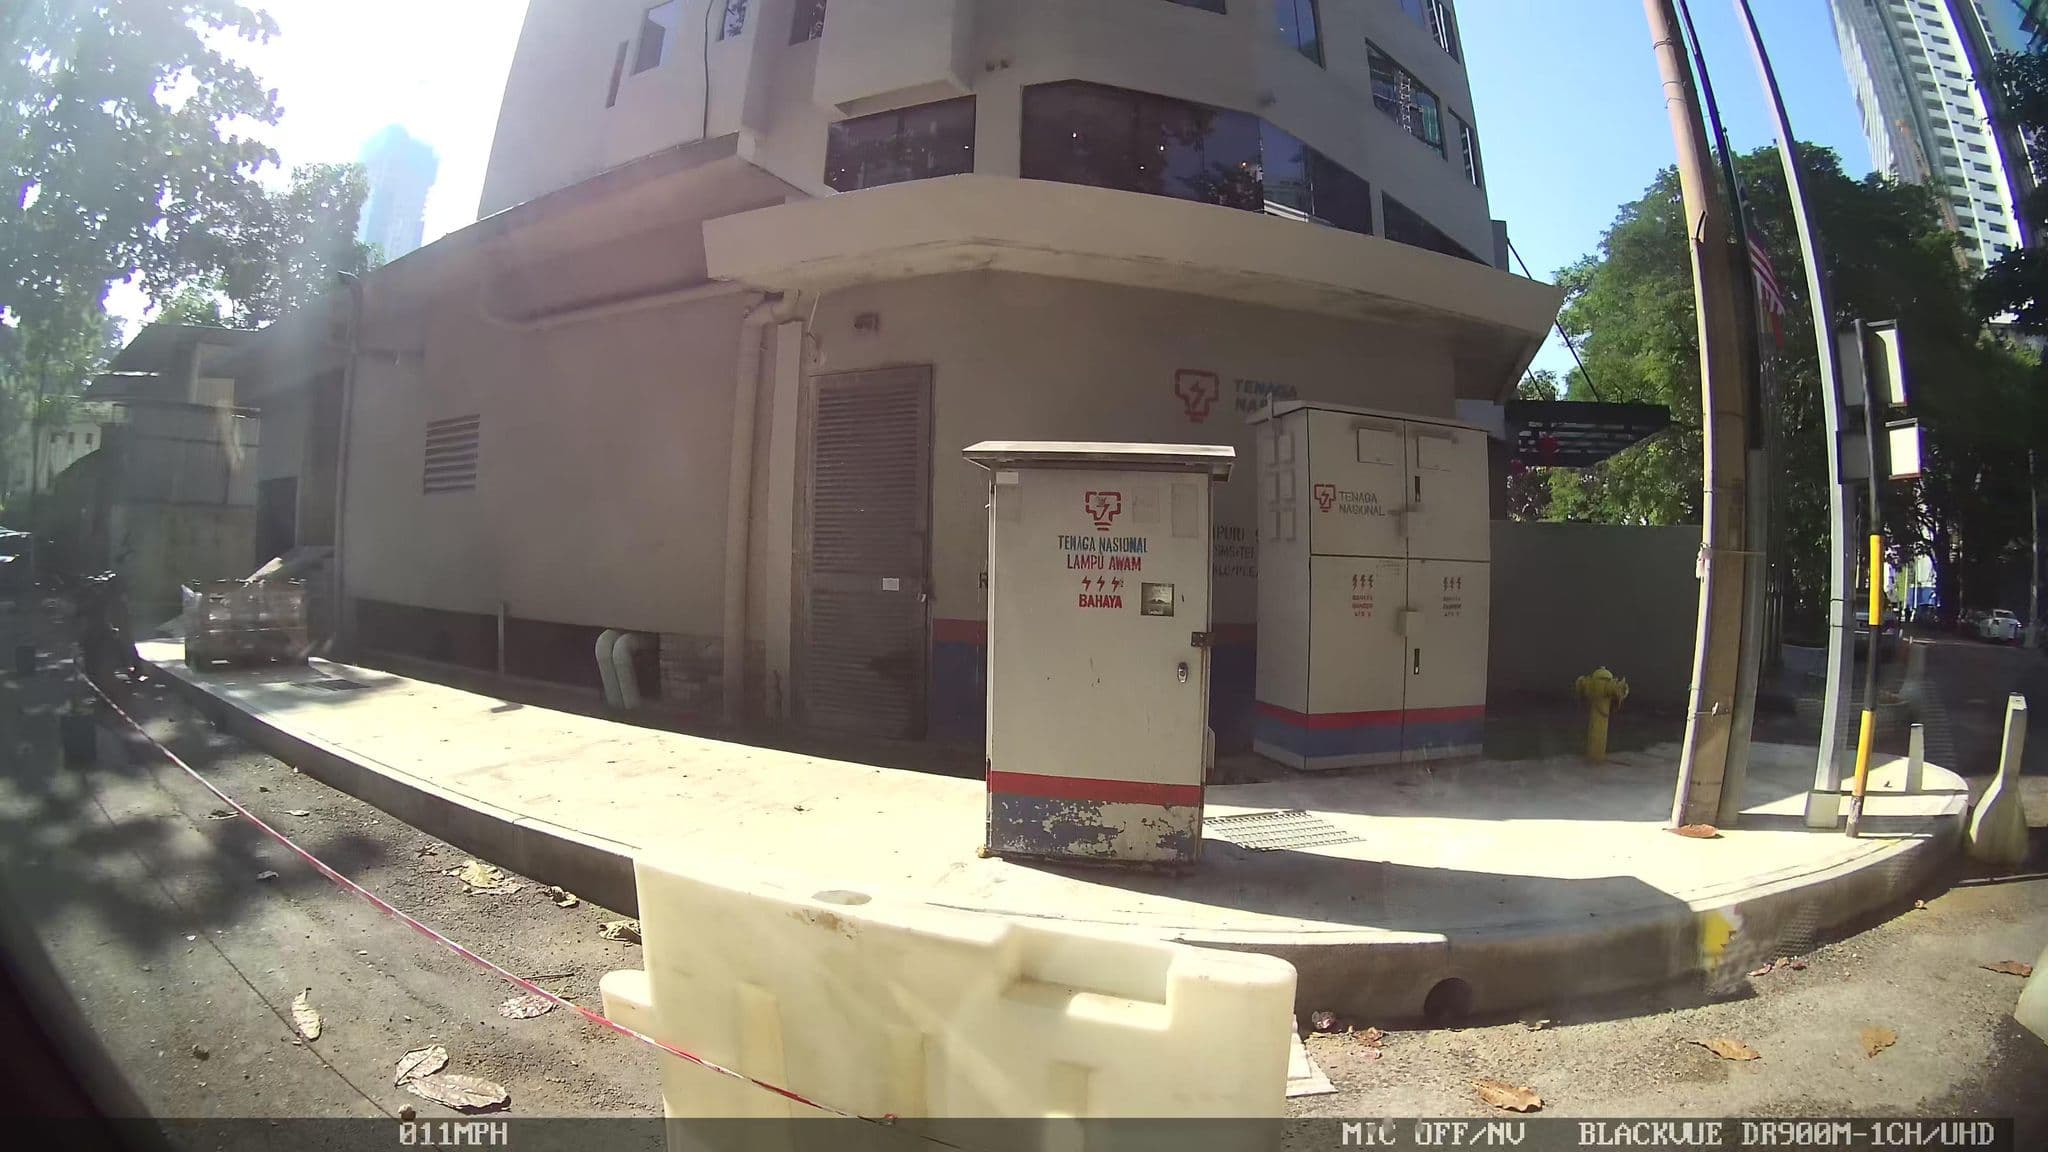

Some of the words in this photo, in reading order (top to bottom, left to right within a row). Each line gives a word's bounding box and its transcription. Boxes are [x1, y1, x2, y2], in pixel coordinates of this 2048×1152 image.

[1338, 491, 1377, 504] TENAGA
[1339, 503, 1385, 517] NASIONAL
[1058, 535, 1096, 551] TENAGA
[1098, 537, 1148, 553] NASIONAL
[1067, 553, 1104, 570] LAMPU
[1108, 556, 1142, 571] AWAM
[1079, 593, 1123, 609] BAHAYA
